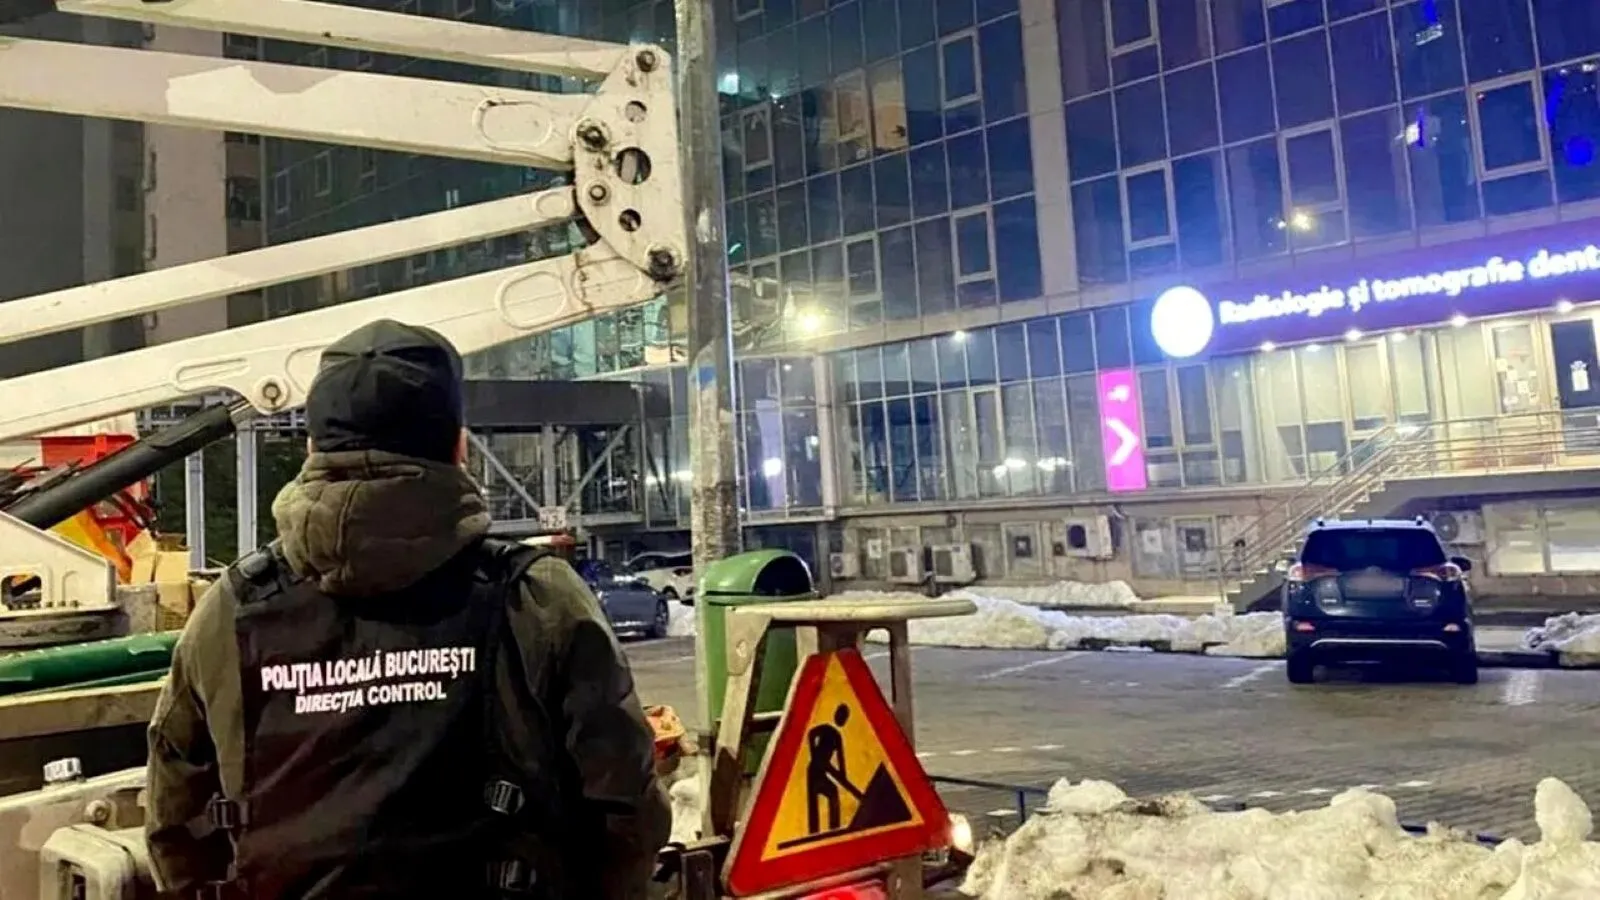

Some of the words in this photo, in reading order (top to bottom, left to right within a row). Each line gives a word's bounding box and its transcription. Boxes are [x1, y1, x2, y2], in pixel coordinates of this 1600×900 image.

[1219, 285, 1345, 324] Radiologie
[1372, 256, 1525, 301] tomografie
[1527, 245, 1600, 278] dent
[325, 650, 382, 686] LOCALĂ
[367, 681, 447, 705] CONTROL
